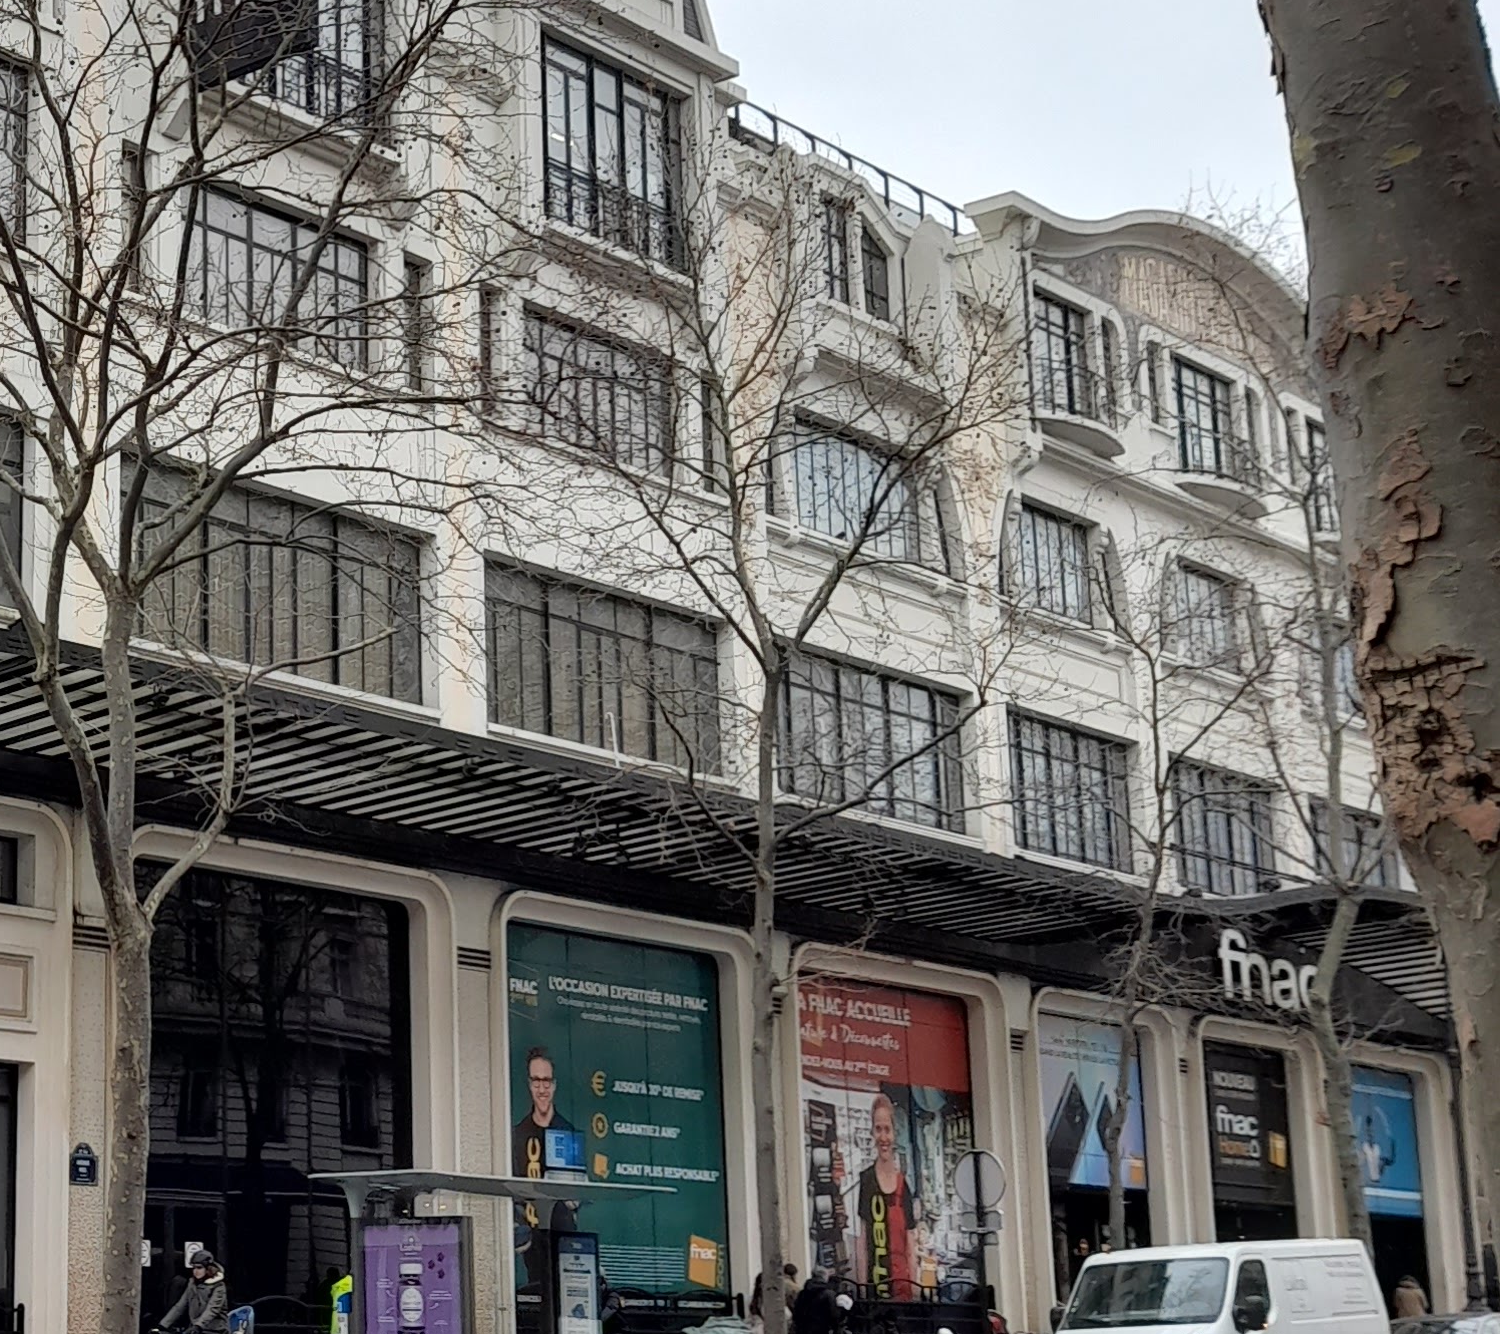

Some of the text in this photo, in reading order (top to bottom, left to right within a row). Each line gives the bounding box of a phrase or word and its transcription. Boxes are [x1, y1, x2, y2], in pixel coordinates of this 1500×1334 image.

[509, 977, 539, 995] FNAC
[1218, 928, 1318, 1013] fnac
[549, 975, 609, 997] L'OCCASION
[664, 994, 682, 1007] PAR
[683, 997, 709, 1012] FNAC
[808, 993, 844, 1017] FNAC
[845, 999, 912, 1027] ACCUEILLE
[1216, 1105, 1259, 1137] fnac
[643, 1164, 663, 1178] PLUS
[689, 1243, 717, 1260] fnac
